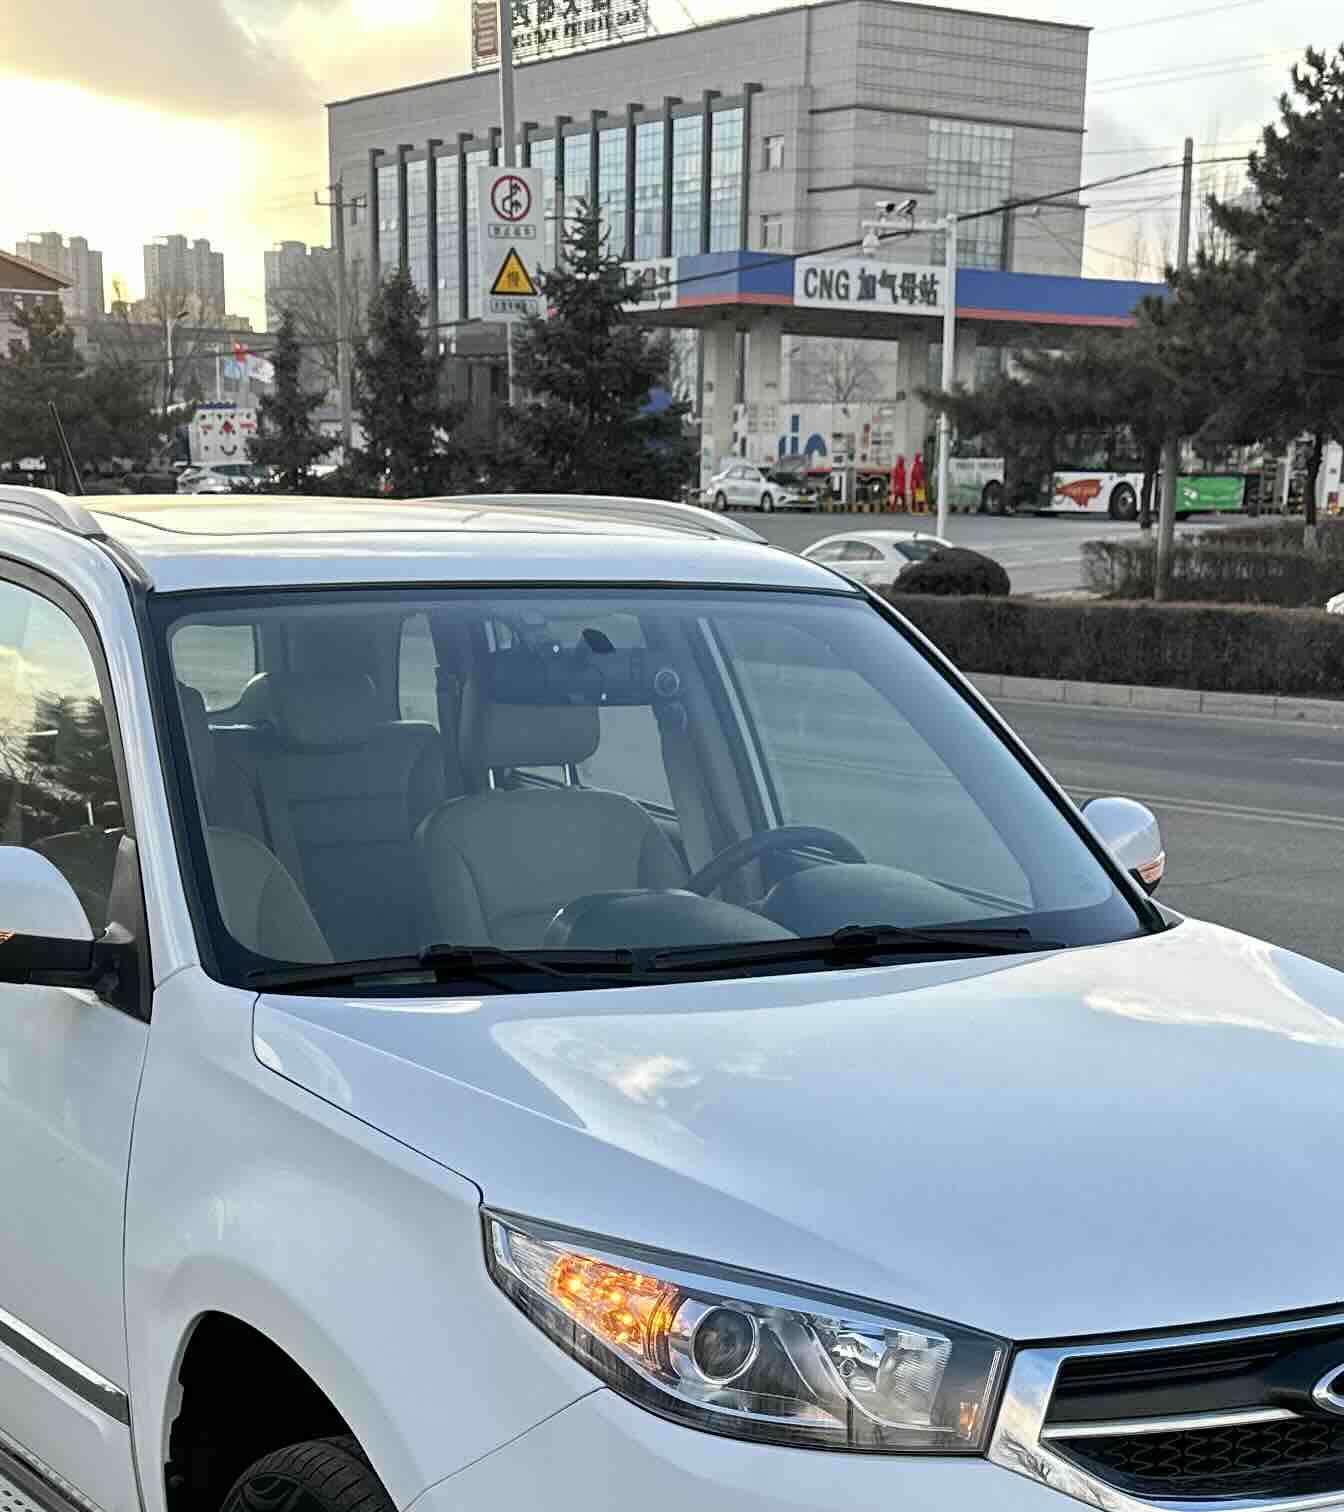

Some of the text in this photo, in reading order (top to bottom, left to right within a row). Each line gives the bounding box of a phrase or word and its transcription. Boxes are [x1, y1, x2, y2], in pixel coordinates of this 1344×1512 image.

[804, 267, 940, 306] CNG 加气母站
